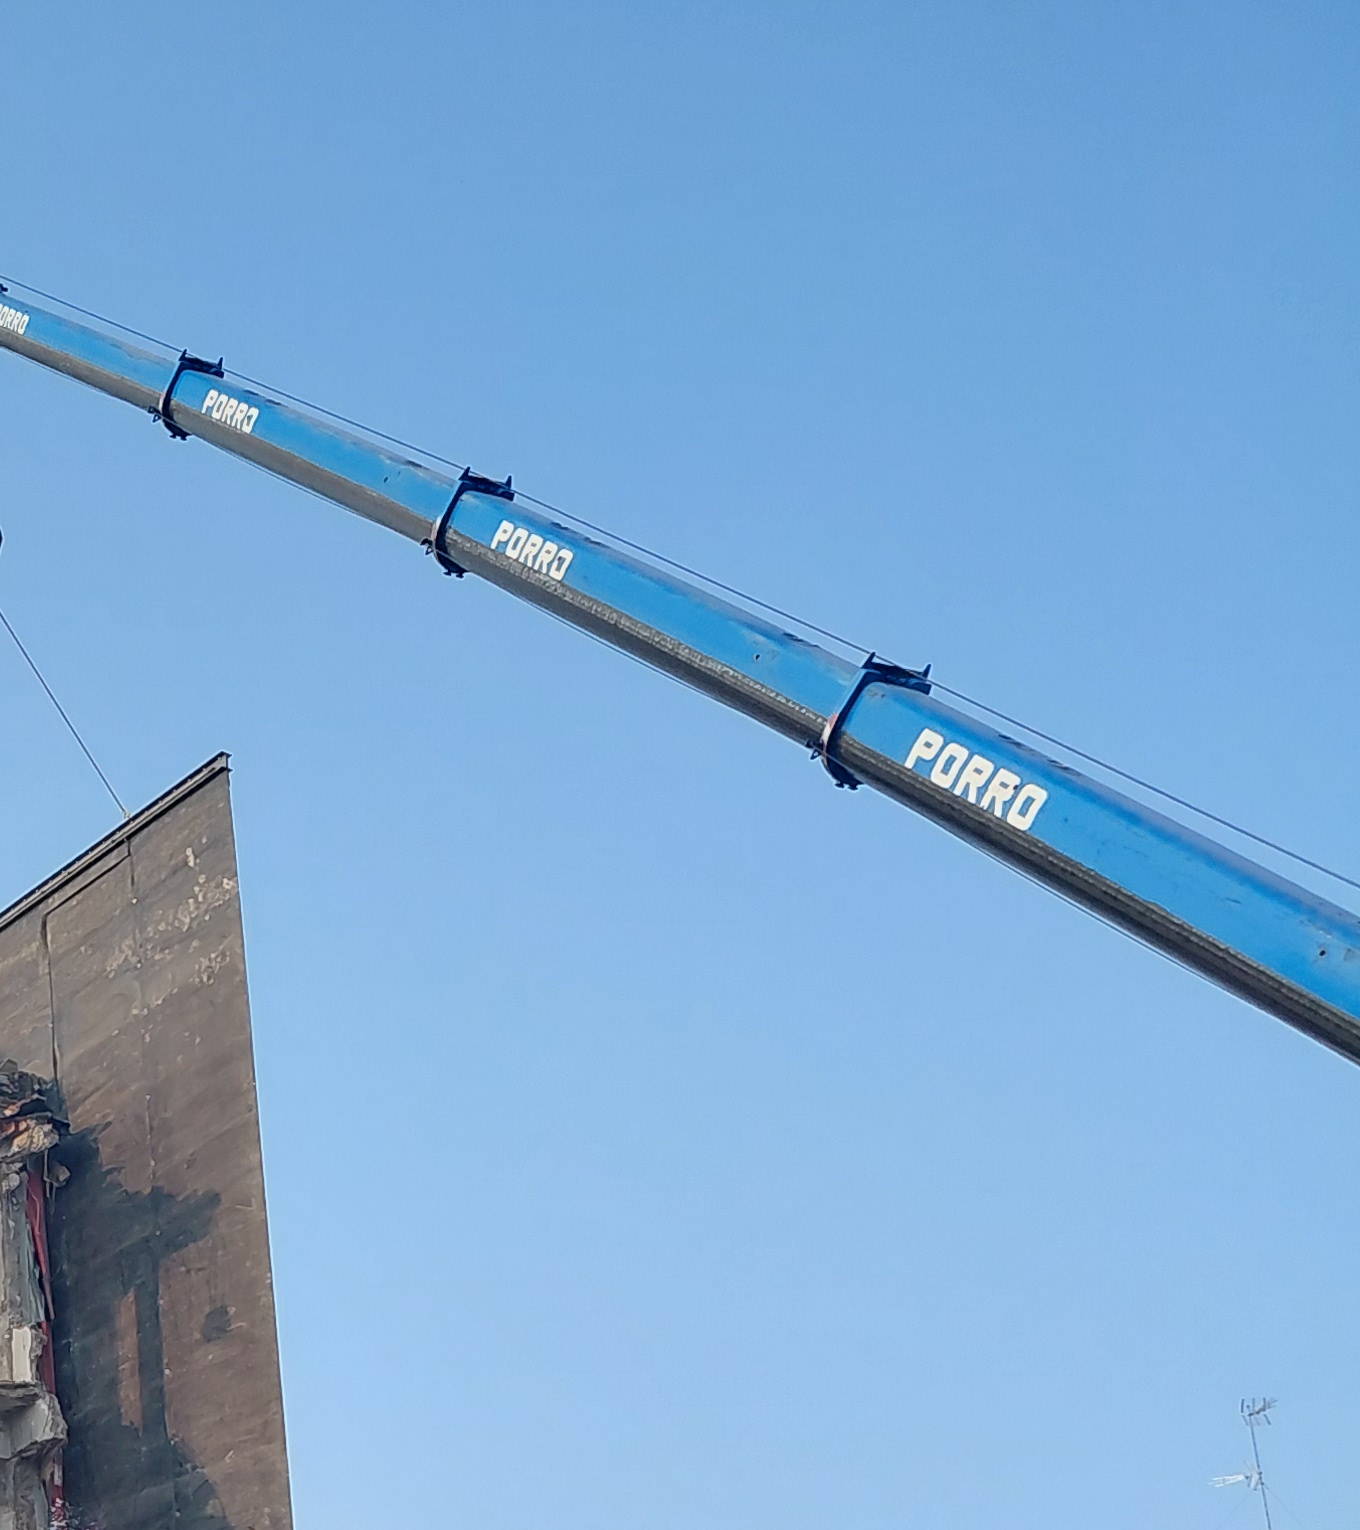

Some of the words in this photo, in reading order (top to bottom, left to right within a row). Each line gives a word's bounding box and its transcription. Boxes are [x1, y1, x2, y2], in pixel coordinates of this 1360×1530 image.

[201, 389, 260, 434] PORRO
[490, 520, 574, 581] PORRO
[904, 728, 1048, 831] PORRO
